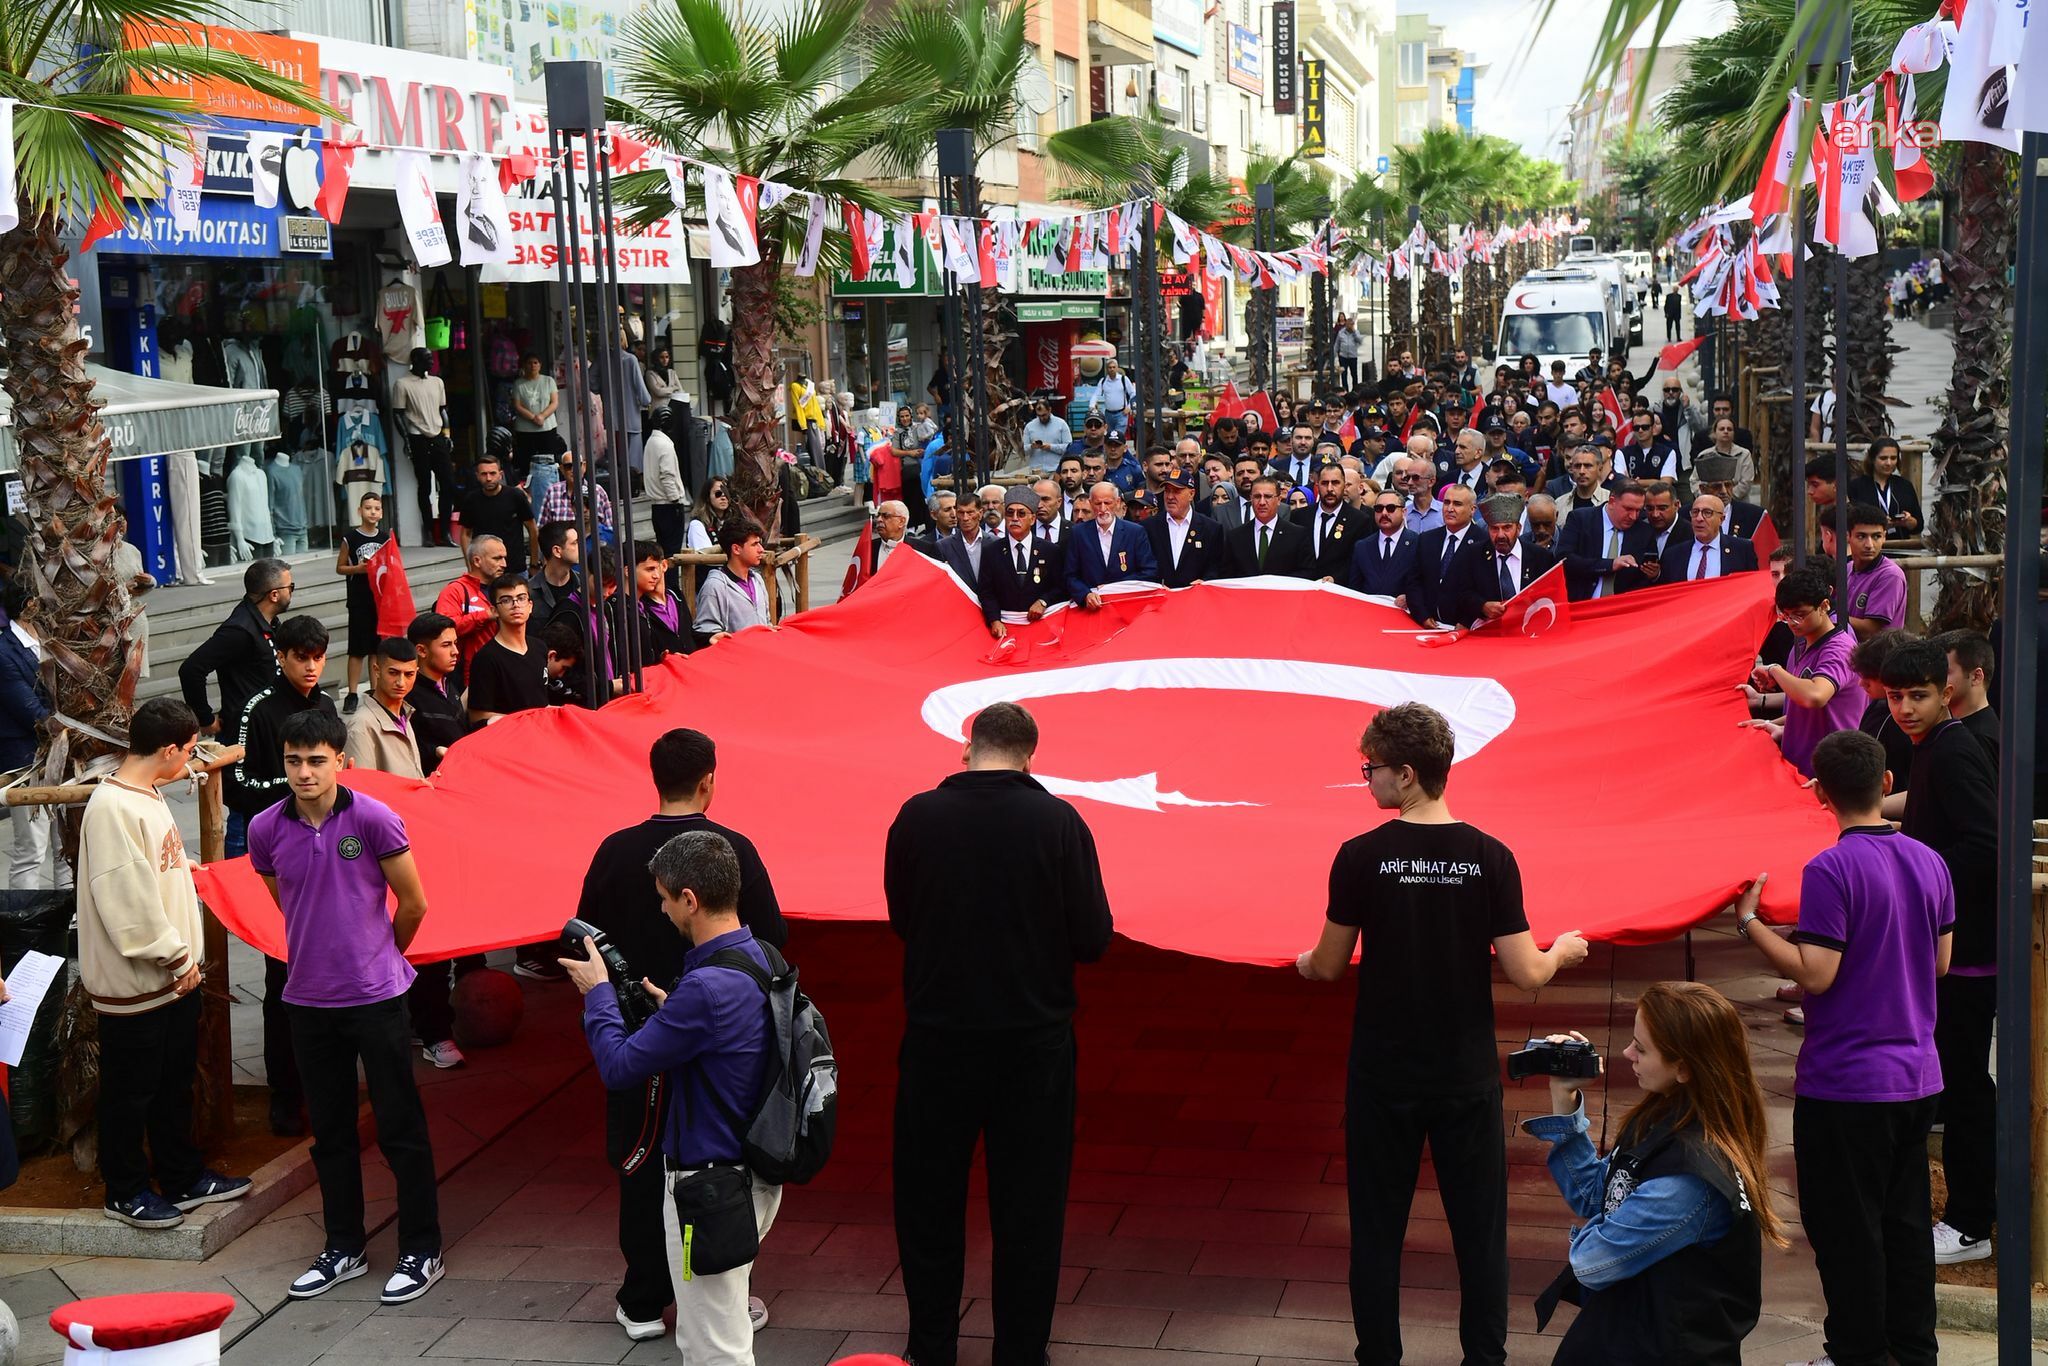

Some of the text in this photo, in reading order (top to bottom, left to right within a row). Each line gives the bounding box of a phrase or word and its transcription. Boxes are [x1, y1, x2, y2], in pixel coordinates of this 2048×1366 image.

[1279, 63, 1289, 100] KURSU
[321, 68, 510, 159] EMRE
[1307, 62, 1322, 143] LİLA
[189, 218, 267, 246] NOKTASI
[289, 219, 328, 236] RENK
[289, 233, 328, 249] İLETİŞİM
[1379, 857, 1482, 876] ARİF NİHAT ASYA
[1399, 874, 1463, 885] ANADOLU LİSESİ
[624, 1147, 645, 1171] Canon
